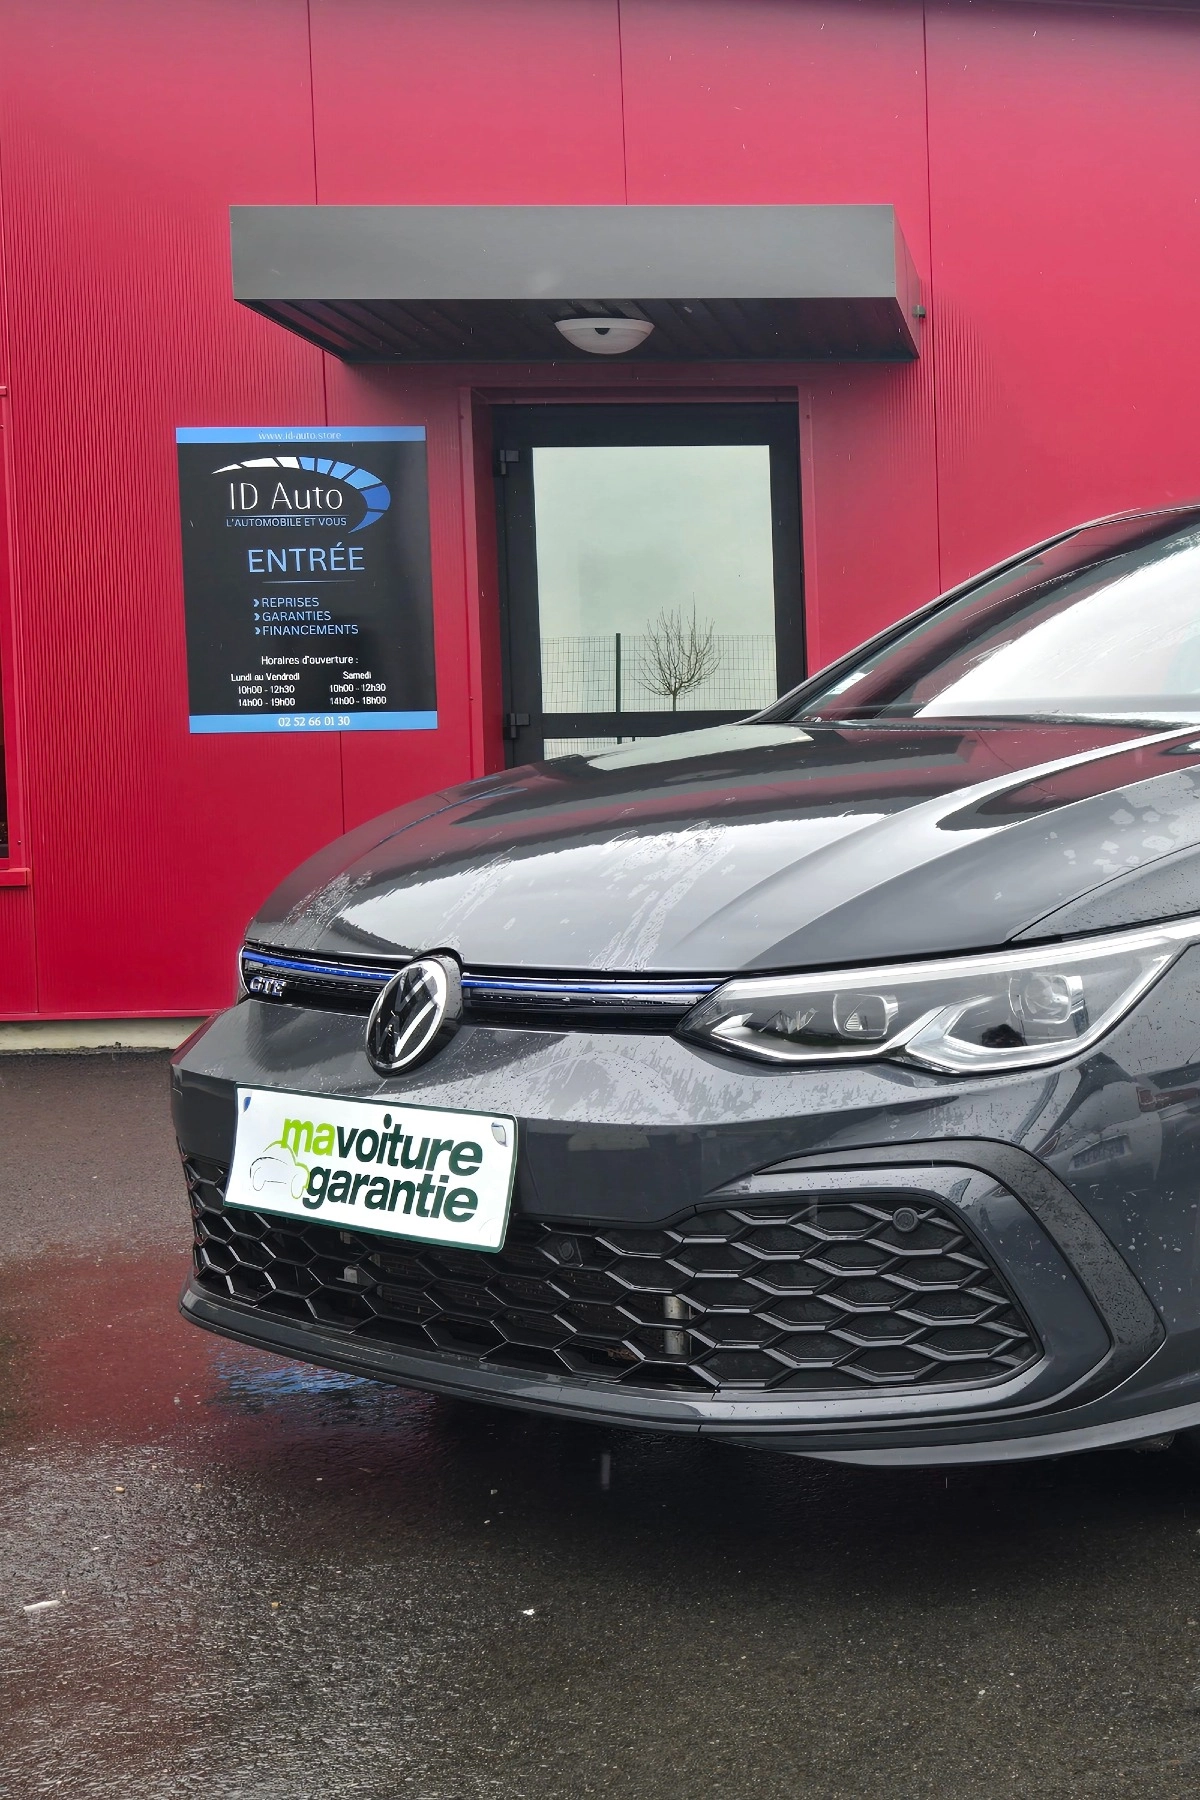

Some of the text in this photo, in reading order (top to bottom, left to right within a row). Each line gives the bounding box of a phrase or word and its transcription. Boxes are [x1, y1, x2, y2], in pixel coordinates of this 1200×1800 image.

[258, 430, 342, 441] www.id-auto.store
[229, 481, 343, 511] ID Auto
[226, 517, 347, 528] L'AUTOMOBILE ET VOUS
[247, 541, 365, 573] ENTRÉE
[261, 597, 320, 608] REPRISES
[262, 610, 331, 622] GARANTIES
[262, 624, 359, 636] FINANCEMENTS
[261, 655, 300, 666] Horaires
[302, 654, 354, 665] d'ouverture
[230, 672, 300, 682] Lundi au Vendredi
[342, 670, 372, 680] Samedi
[238, 685, 263, 695] 10h00
[270, 684, 295, 694] 12h30
[329, 684, 354, 693] 10h00
[362, 683, 387, 692] 12h30
[238, 698, 263, 707] 14h00
[271, 697, 296, 707] 19h00
[329, 696, 355, 705] 14h00
[278, 716, 350, 727] 02 52 66 01 30
[249, 976, 286, 997] GTE
[302, 1163, 479, 1223] garantie
